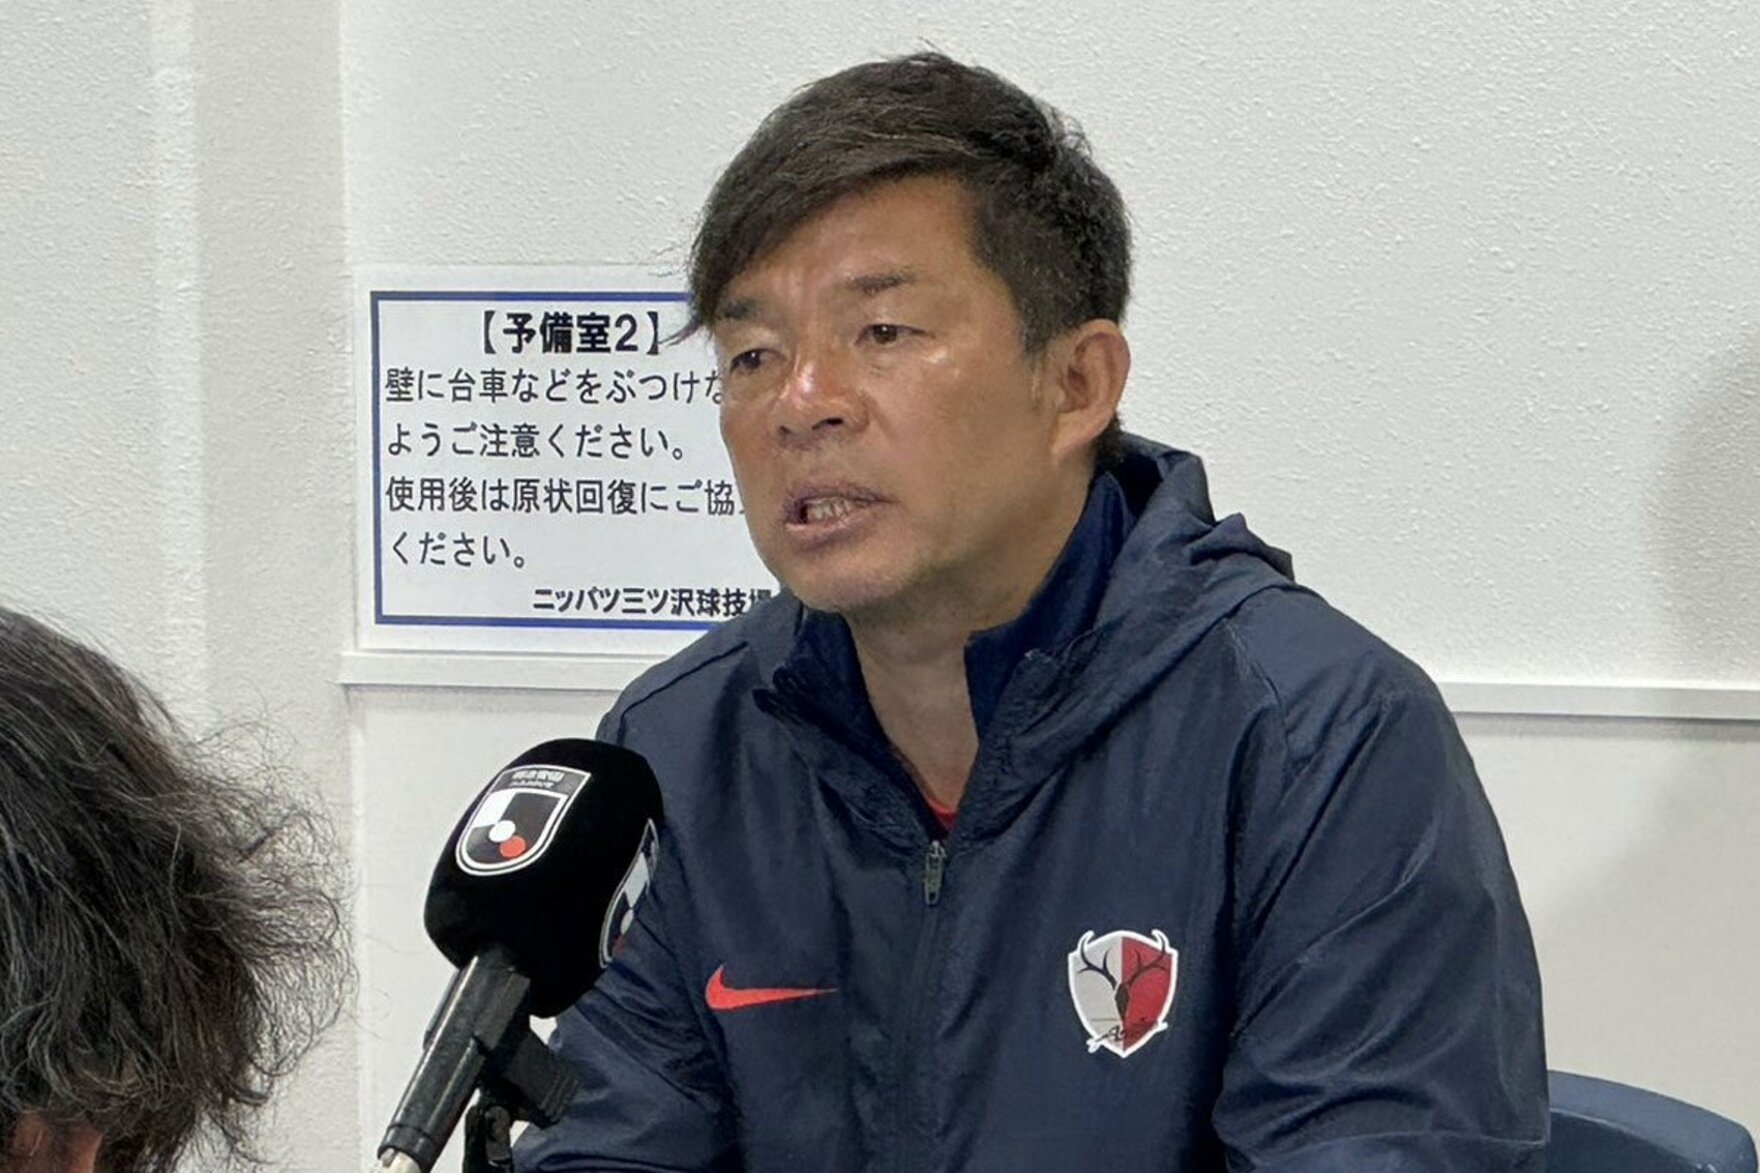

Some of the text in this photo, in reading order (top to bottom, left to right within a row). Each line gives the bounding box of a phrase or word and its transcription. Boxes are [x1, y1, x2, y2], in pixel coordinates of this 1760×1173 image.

[484, 310, 659, 355] 【予備室2】
[387, 422, 683, 460] ようご注意ください。
[385, 477, 745, 516] 使用後は原状回復にご協
[392, 531, 525, 569] ください。
